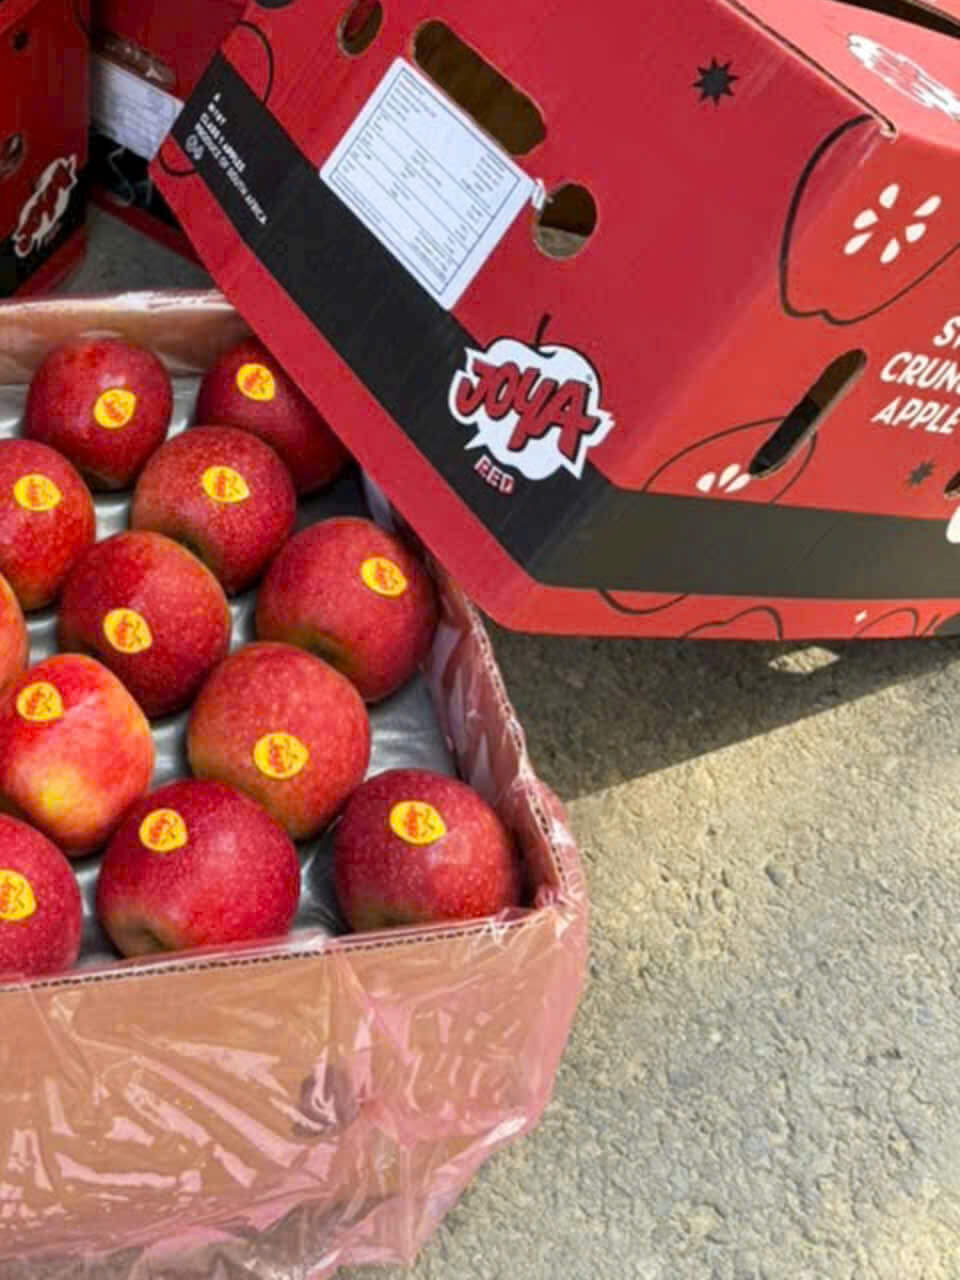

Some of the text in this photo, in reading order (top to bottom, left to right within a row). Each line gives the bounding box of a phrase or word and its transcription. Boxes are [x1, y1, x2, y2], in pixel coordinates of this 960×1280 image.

[880, 351, 960, 395] CRUN
[455, 357, 602, 463] JOYA
[871, 396, 960, 436] APPLE
[473, 455, 515, 495] RED
